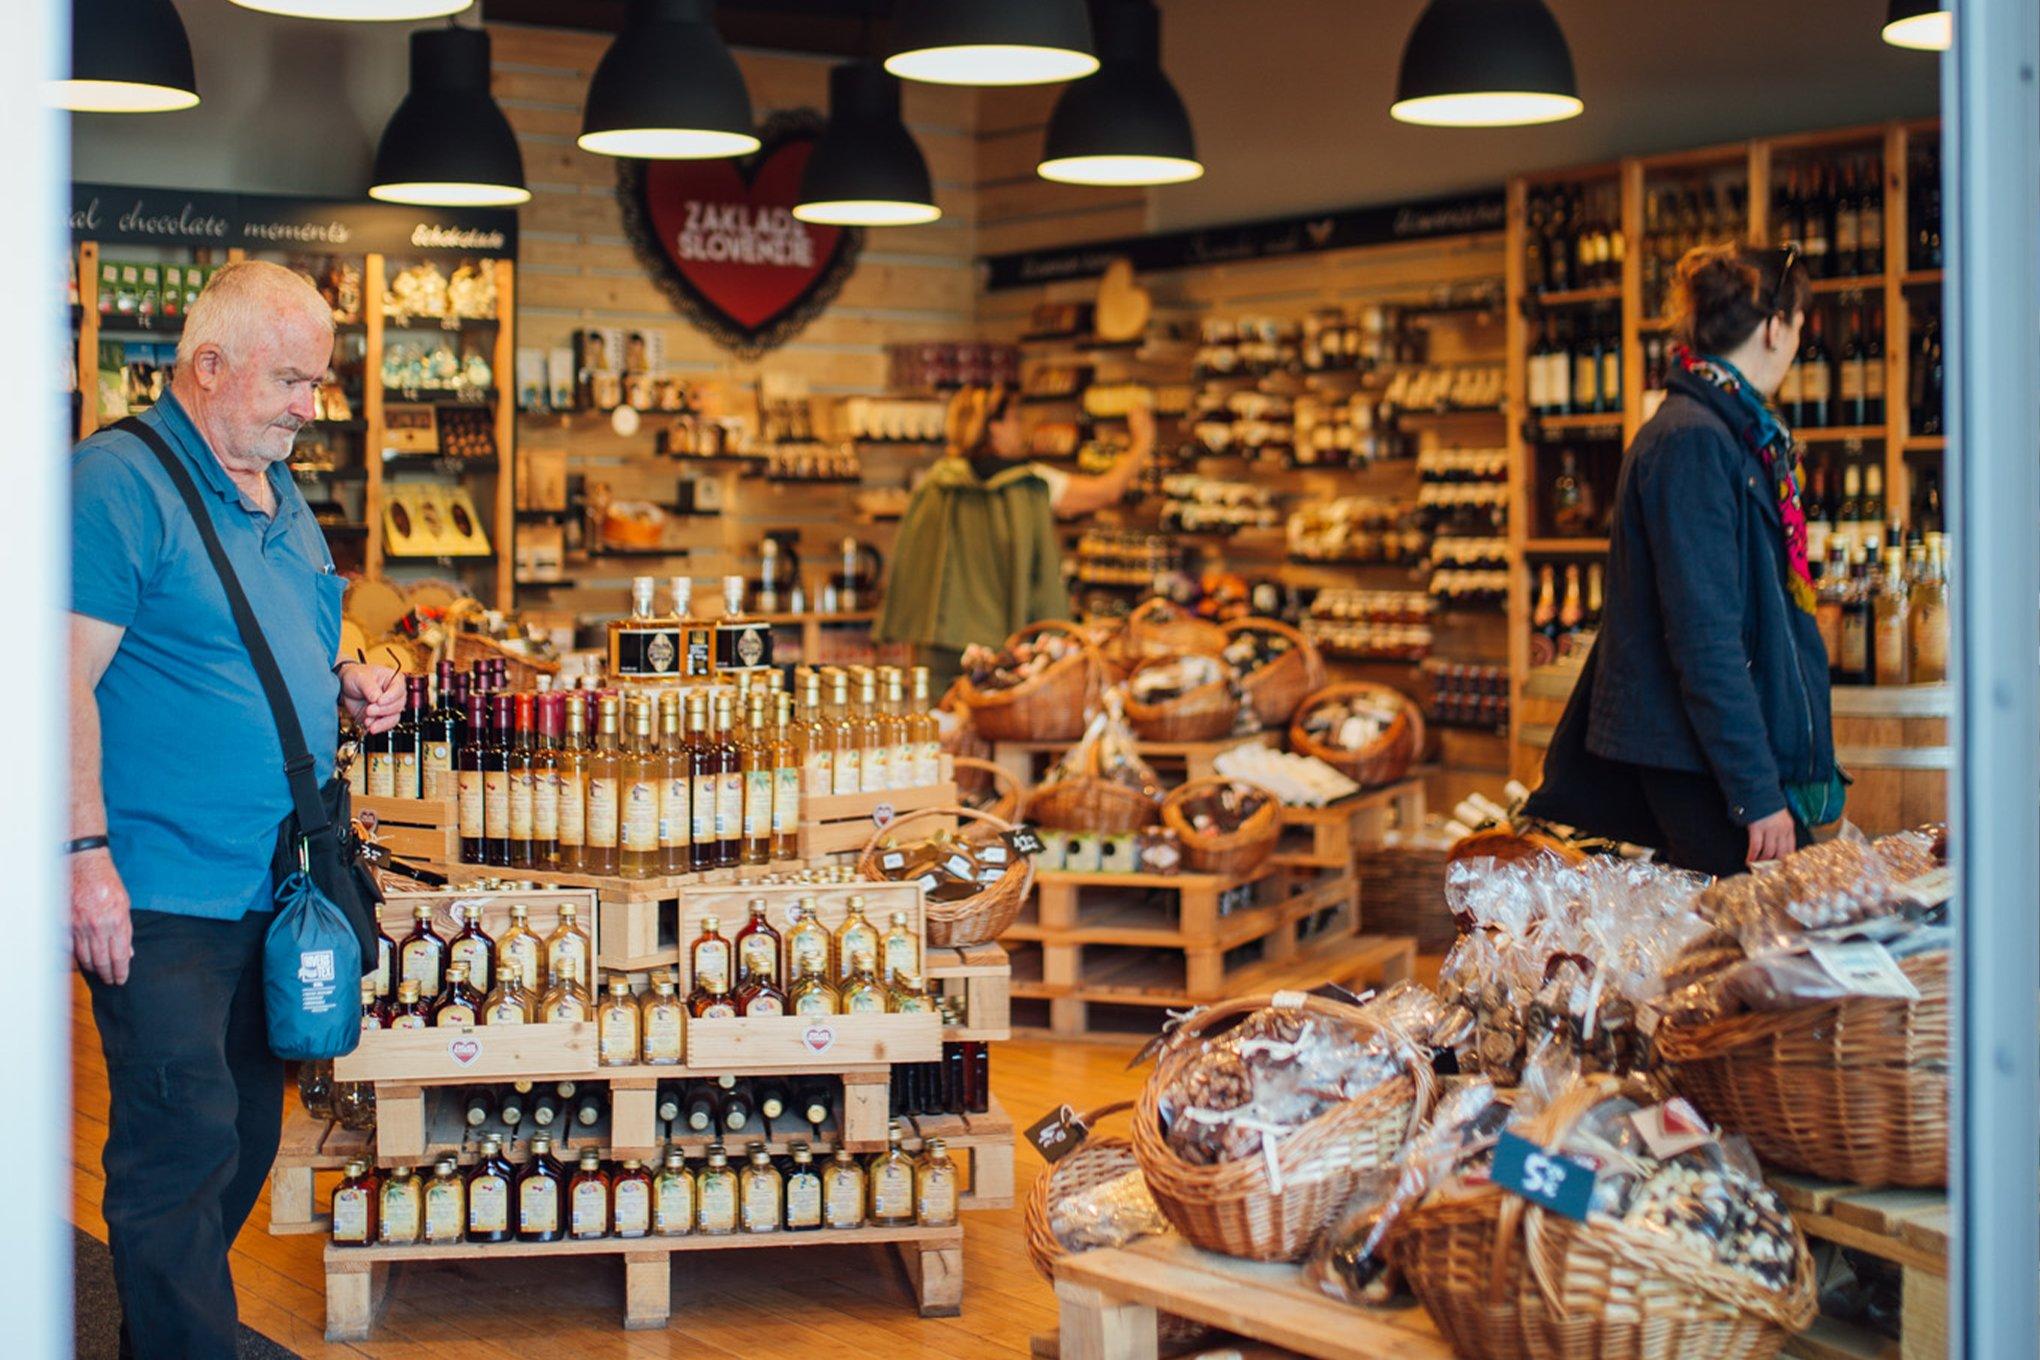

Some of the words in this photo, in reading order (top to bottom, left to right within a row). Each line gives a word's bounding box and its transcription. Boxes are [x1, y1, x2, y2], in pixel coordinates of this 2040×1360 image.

[69, 198, 99, 231] al
[118, 199, 228, 238] chocolate
[243, 219, 350, 244] moments
